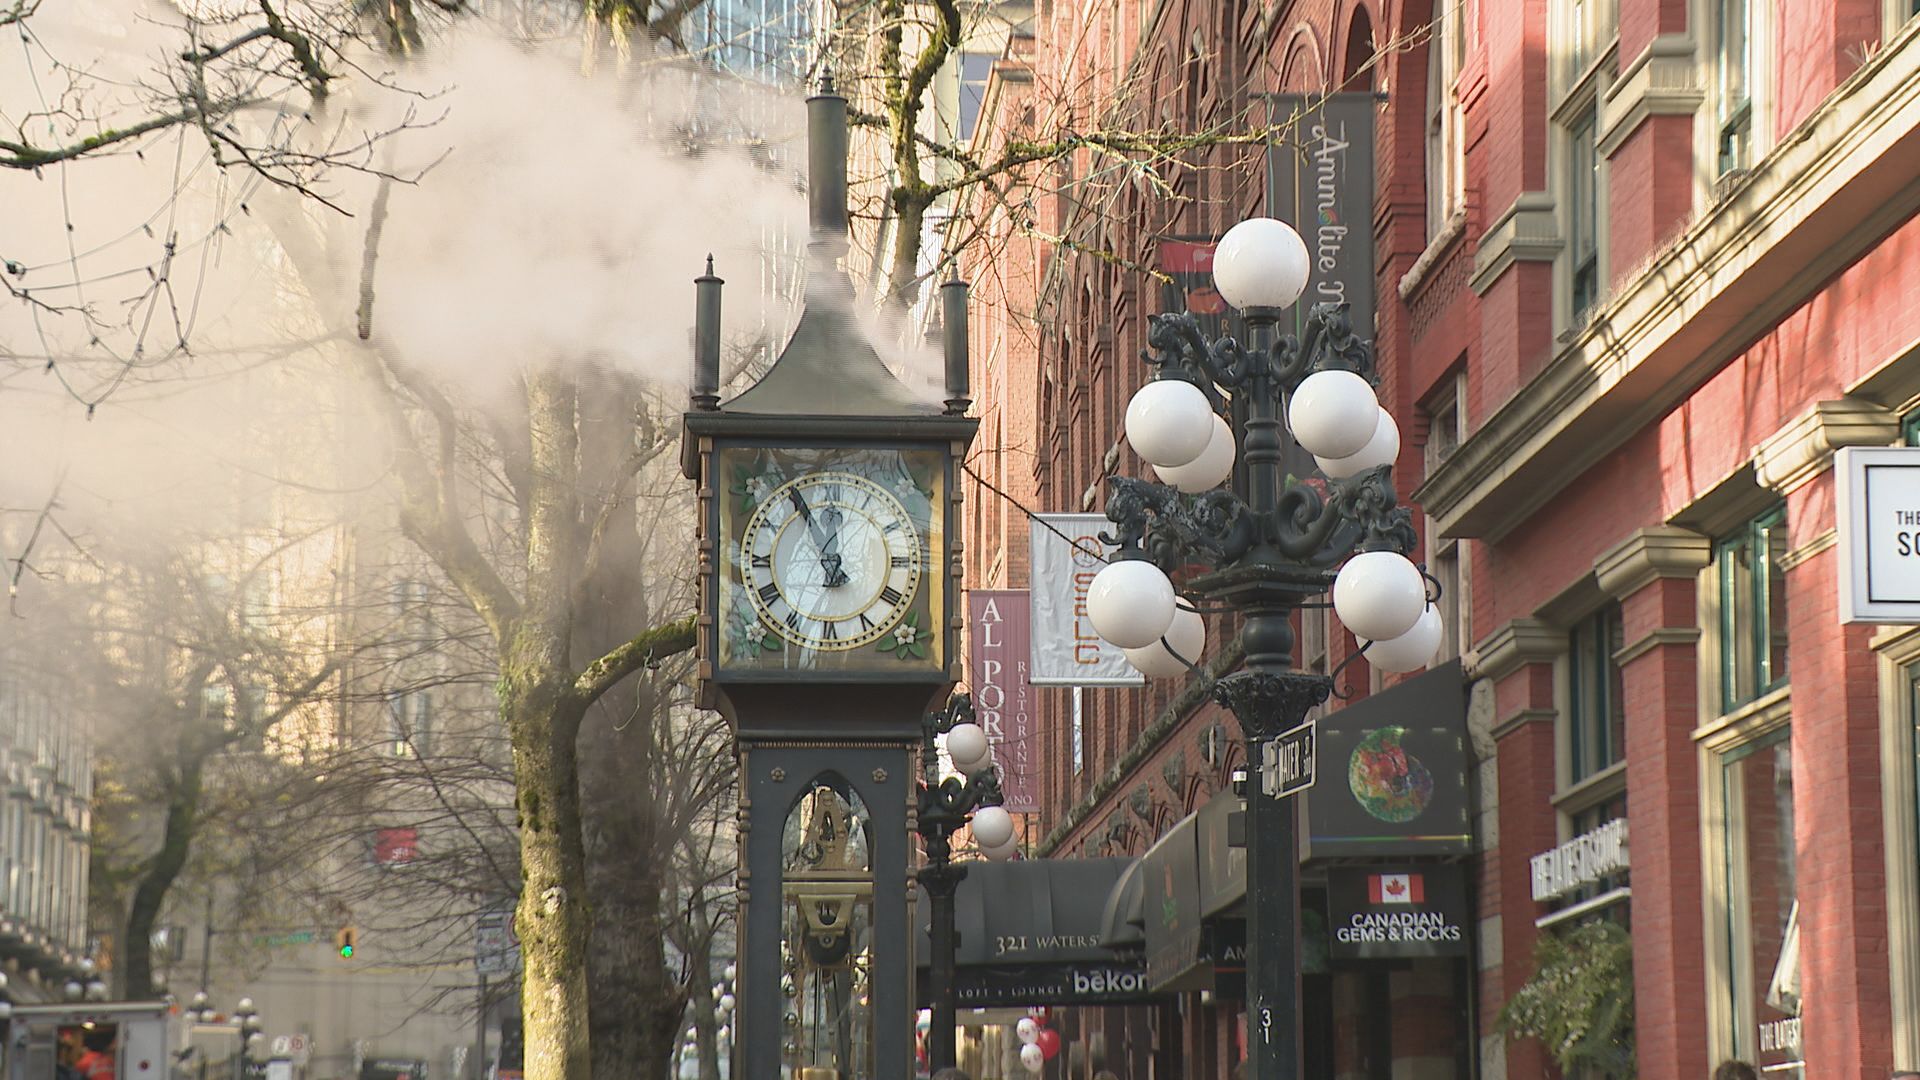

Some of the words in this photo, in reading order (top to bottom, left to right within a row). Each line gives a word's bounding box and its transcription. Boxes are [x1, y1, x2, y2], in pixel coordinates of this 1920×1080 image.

[980, 597, 1003, 647] AL
[1351, 912, 1444, 928] CANADIAN
[1337, 927, 1386, 942] GEMS
[1388, 927, 1401, 941] &
[1403, 926, 1461, 941] ROCKS
[996, 936, 1028, 956] 321
[1036, 935, 1087, 949] WATER
